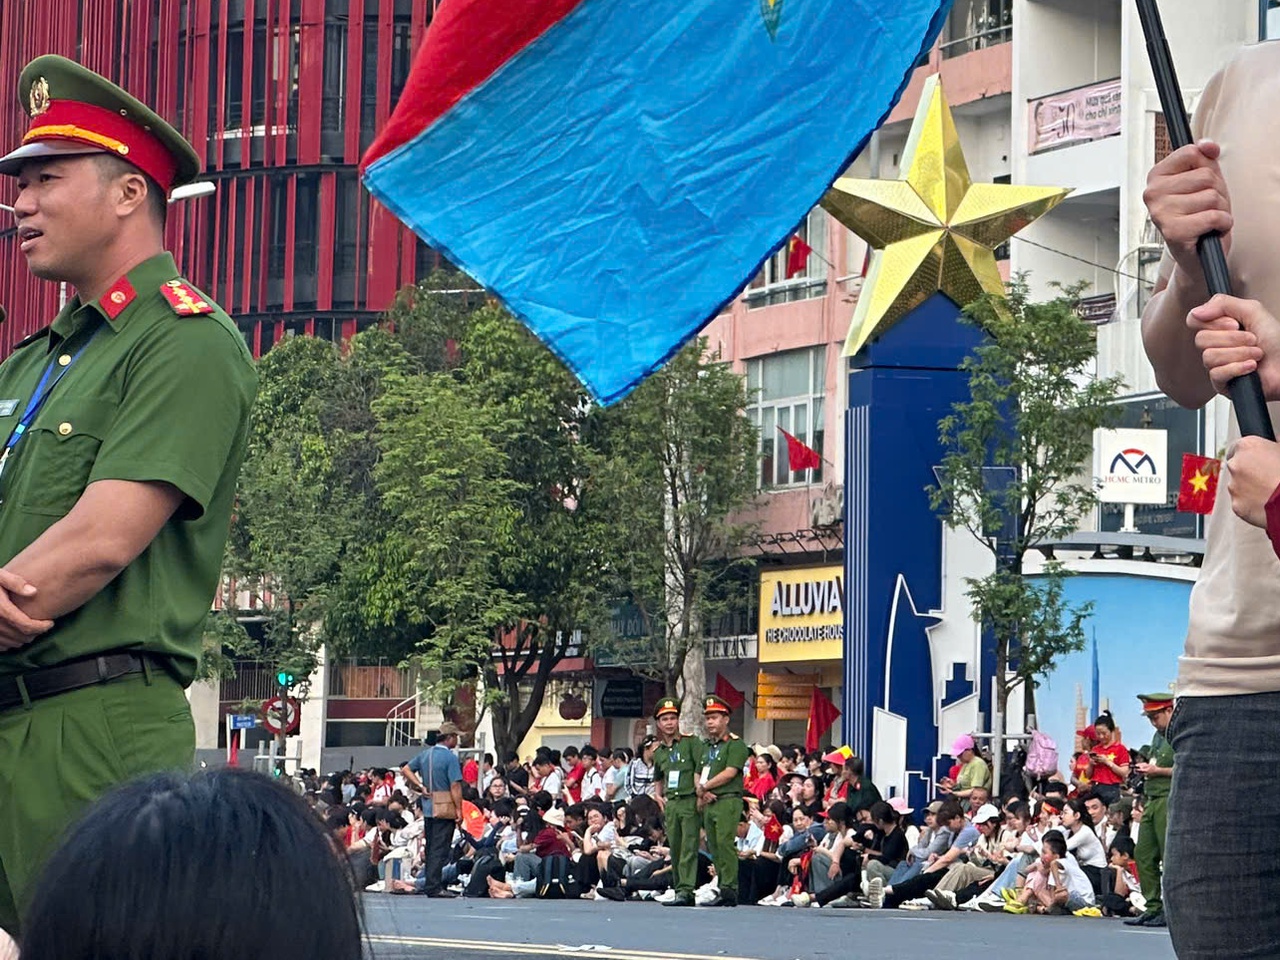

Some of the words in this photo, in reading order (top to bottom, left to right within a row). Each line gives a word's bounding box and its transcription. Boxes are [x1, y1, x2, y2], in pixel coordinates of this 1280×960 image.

[1104, 476, 1130, 484] HCMC
[1133, 477, 1161, 485] METRO
[780, 625, 824, 642] CHOCOLATE
[826, 624, 843, 640] HOUS
